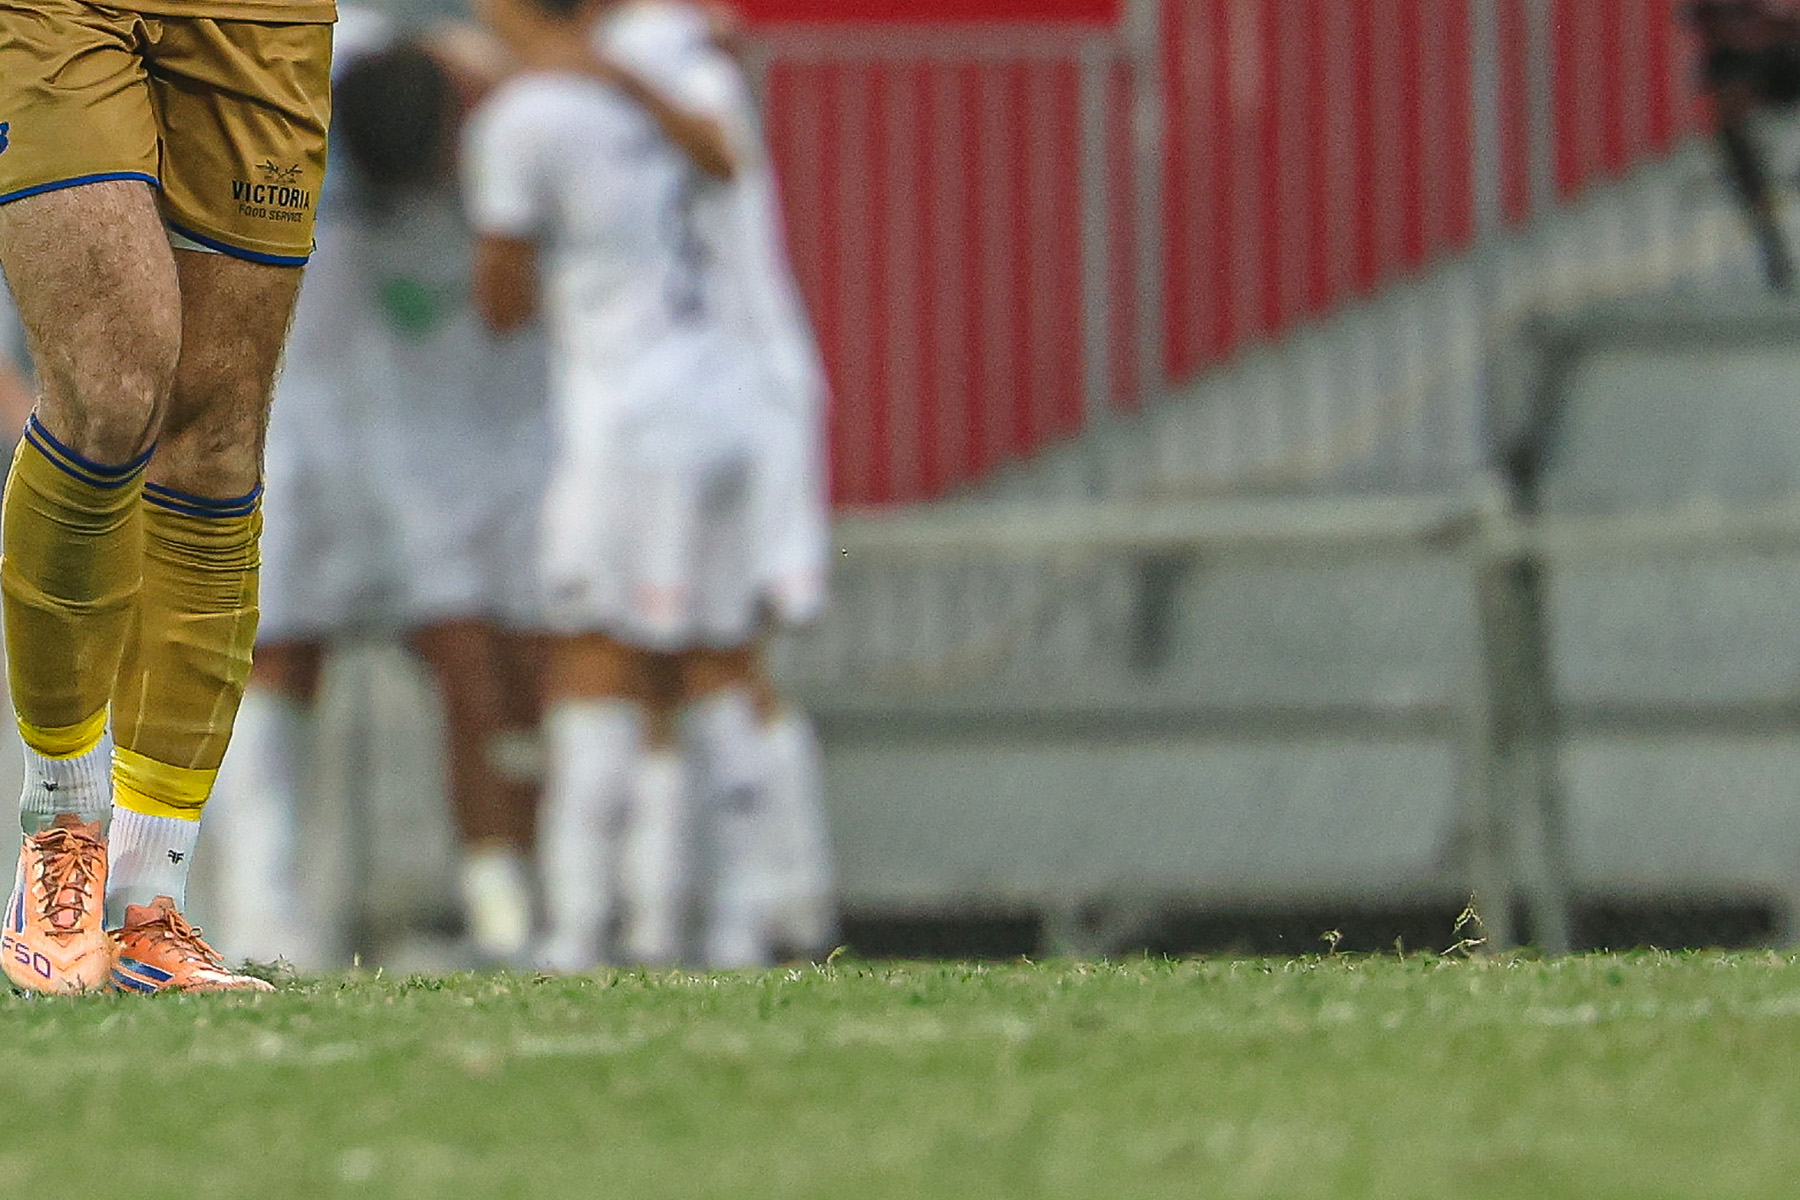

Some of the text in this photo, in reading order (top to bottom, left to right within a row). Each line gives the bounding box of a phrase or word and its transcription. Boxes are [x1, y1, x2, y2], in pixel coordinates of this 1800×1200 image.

[231, 180, 310, 211] VICTORIA
[239, 204, 304, 223] FOOD SERVICE
[2, 935, 51, 980] F50
